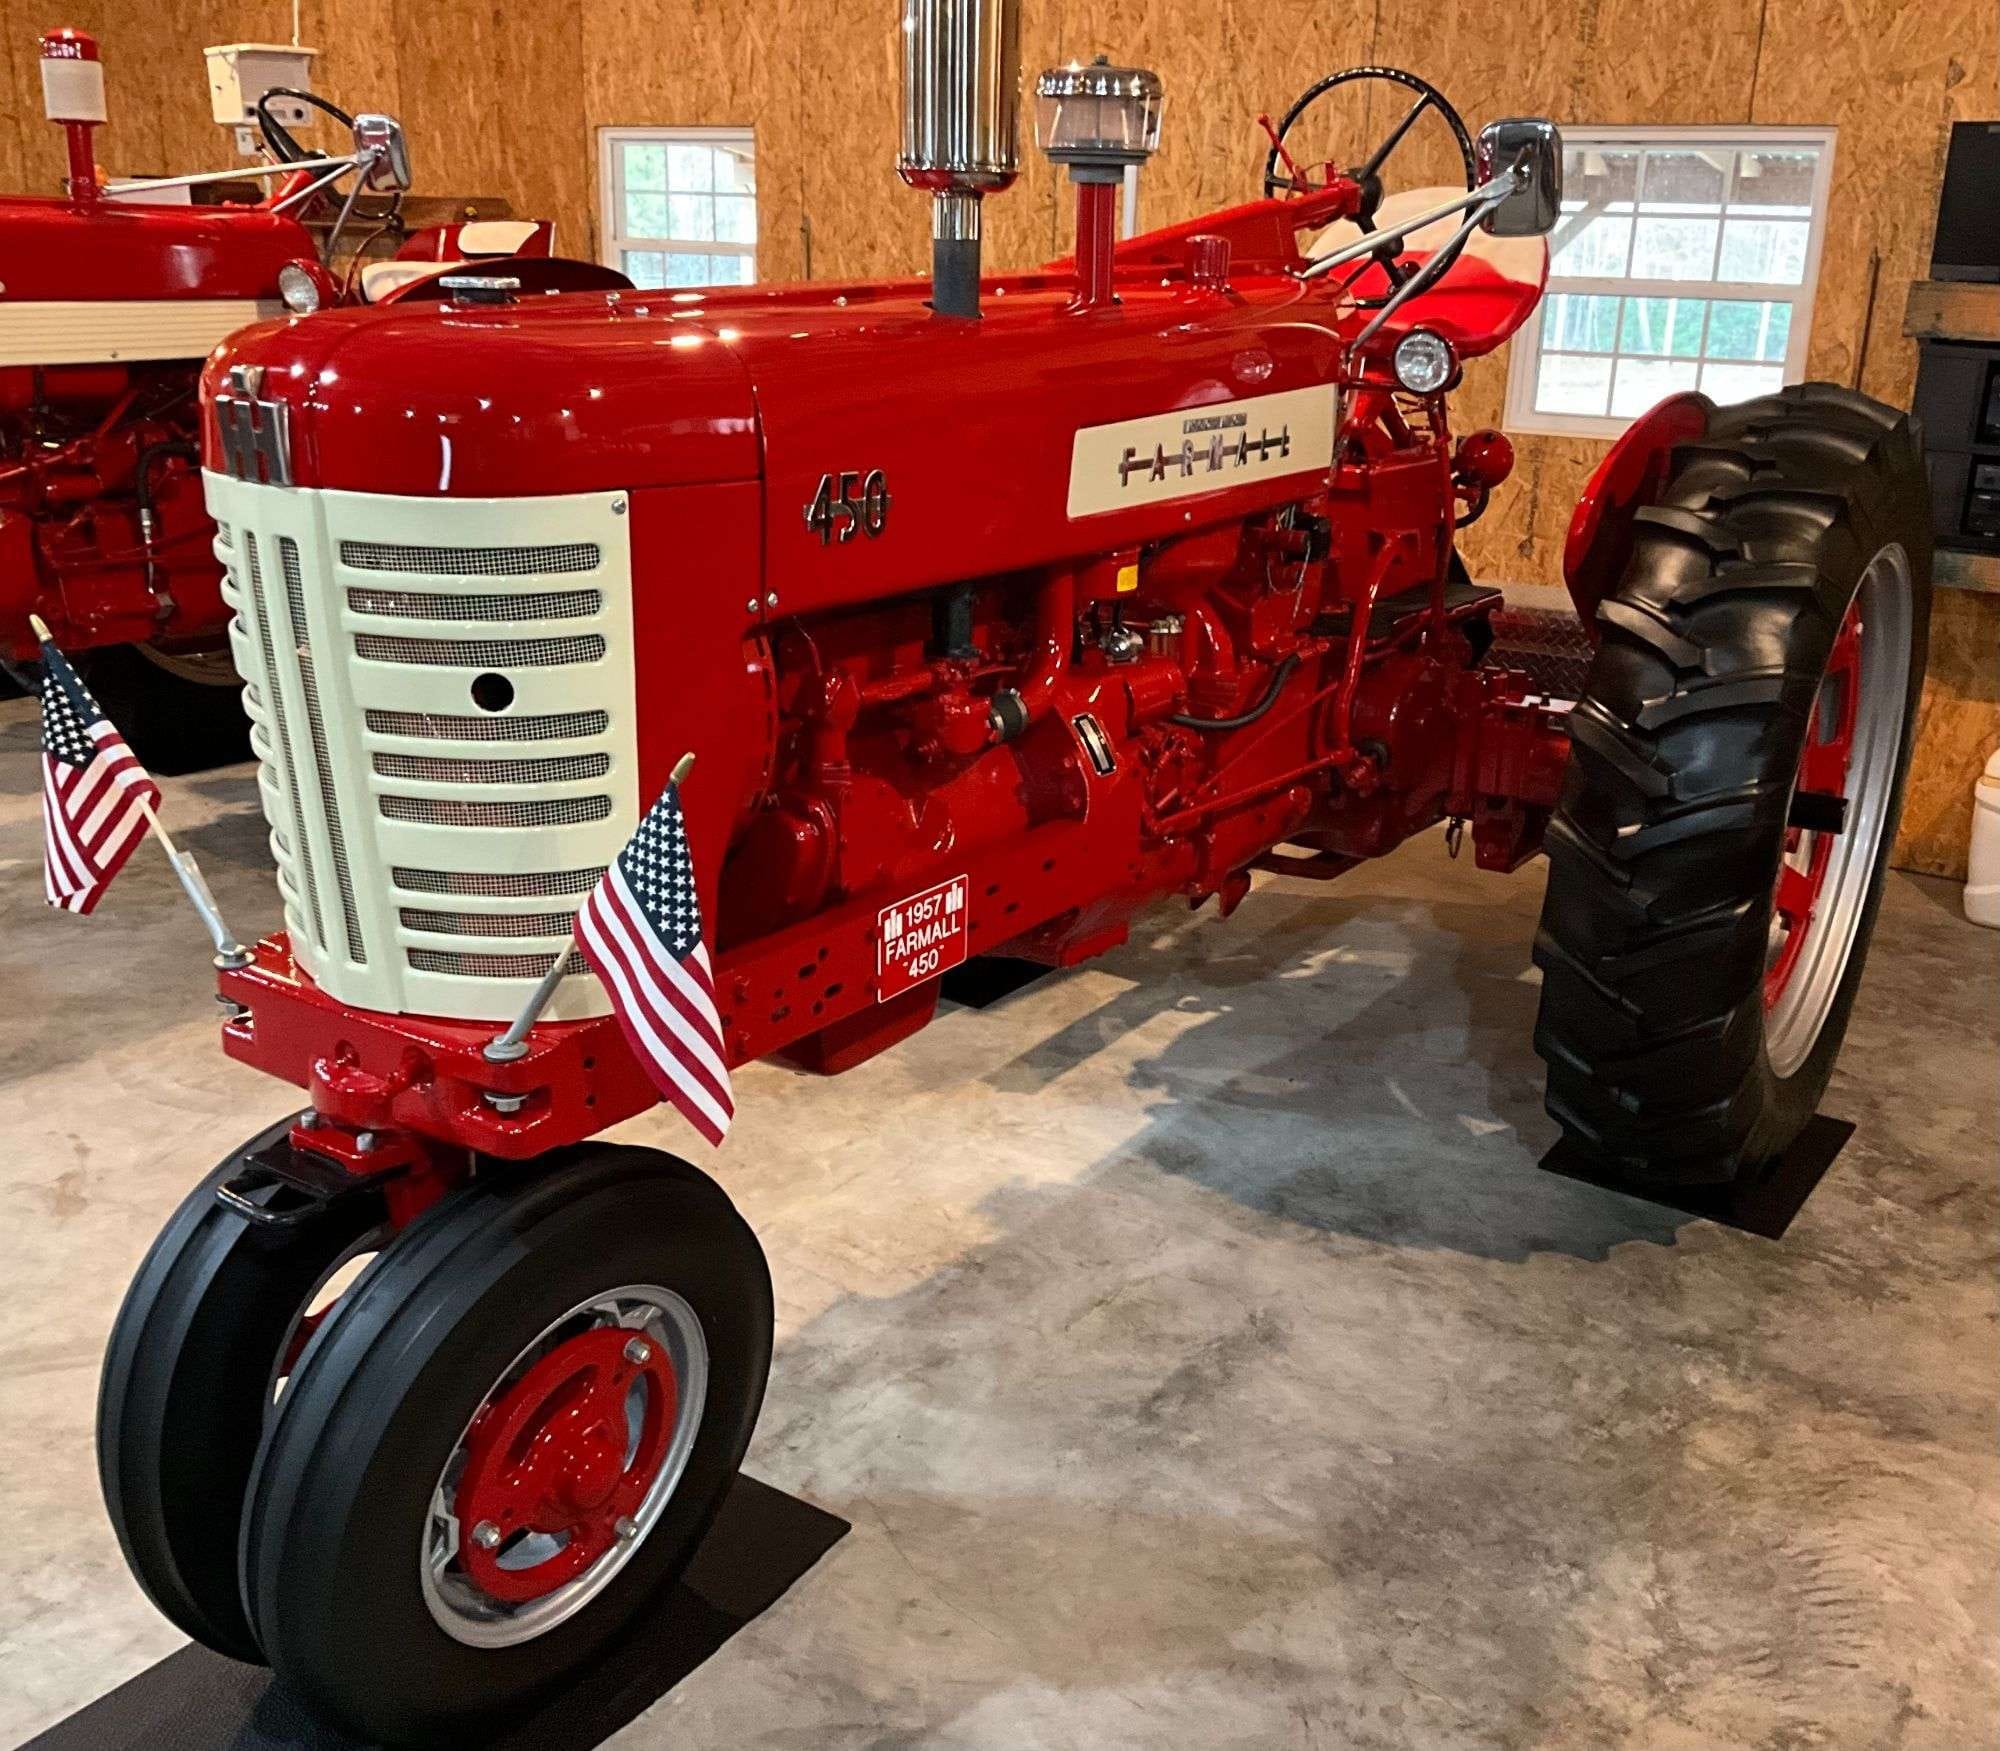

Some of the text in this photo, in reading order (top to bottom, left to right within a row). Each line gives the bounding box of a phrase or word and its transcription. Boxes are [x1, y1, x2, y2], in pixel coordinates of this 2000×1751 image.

[1118, 424, 1290, 487] FARMALL
[805, 468, 889, 545] 450
[905, 893, 943, 927] 1957
[885, 913, 961, 965] FARMALL
